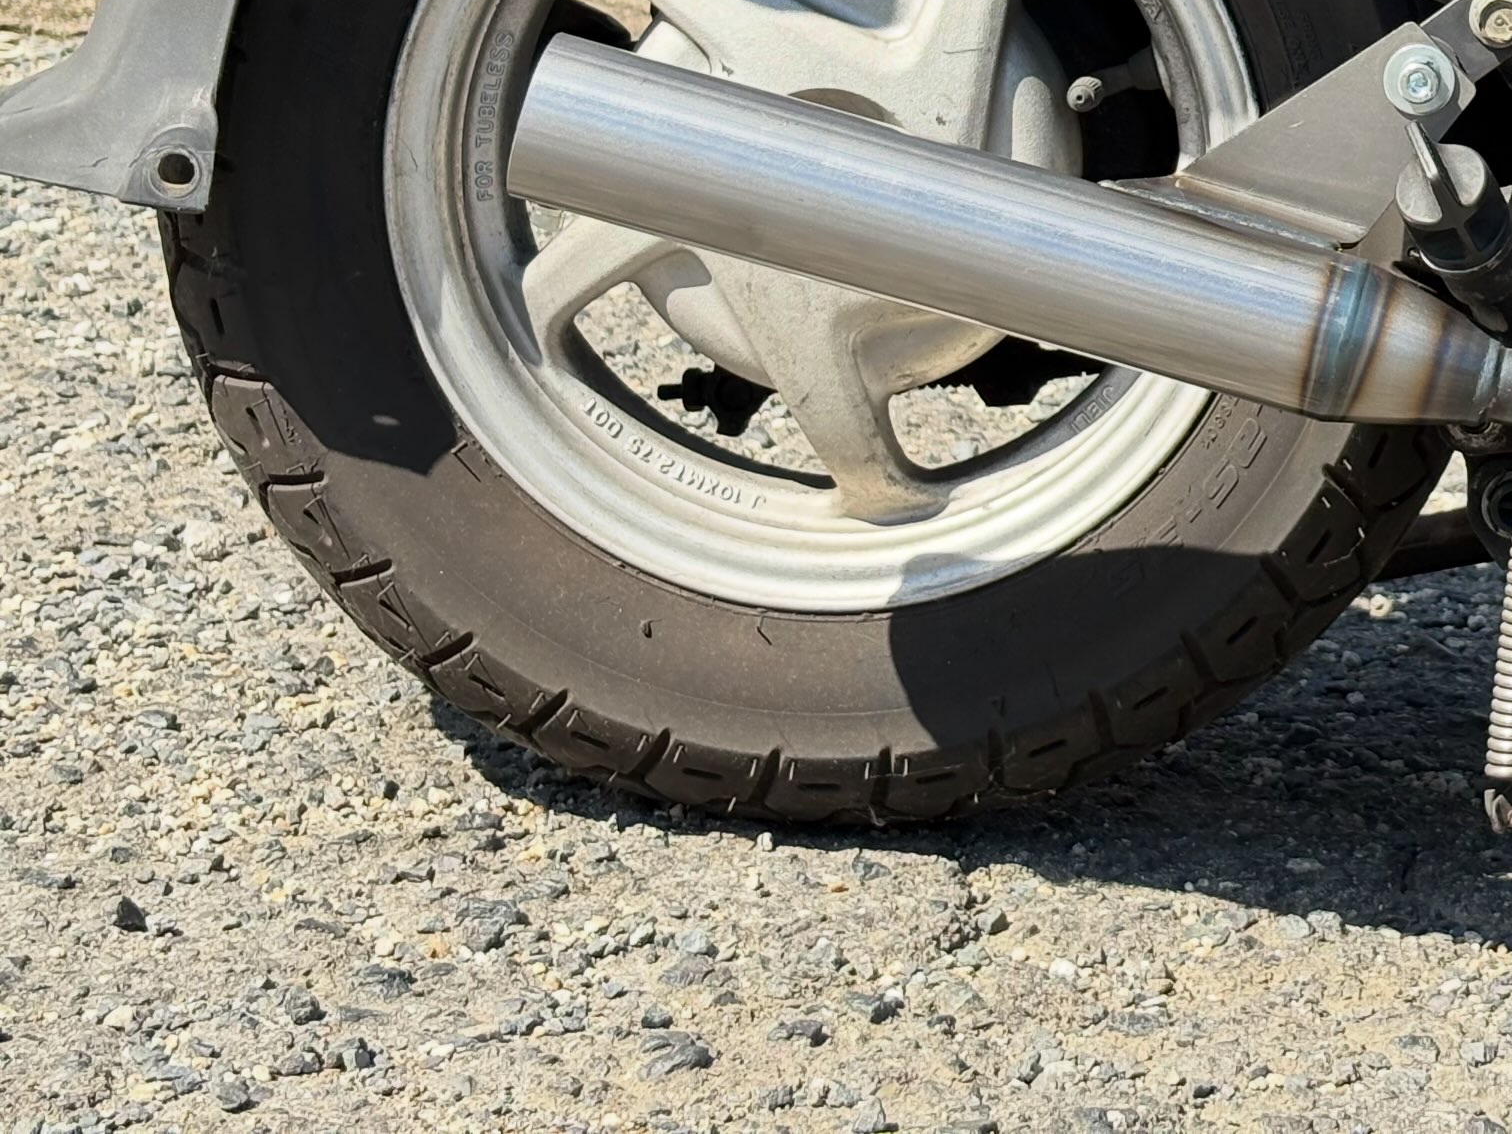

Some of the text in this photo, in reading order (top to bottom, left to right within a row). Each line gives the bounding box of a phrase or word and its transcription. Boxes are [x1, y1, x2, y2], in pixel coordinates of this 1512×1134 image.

[474, 32, 515, 203] FOR TUBELESS
[582, 397, 625, 440] DOT
